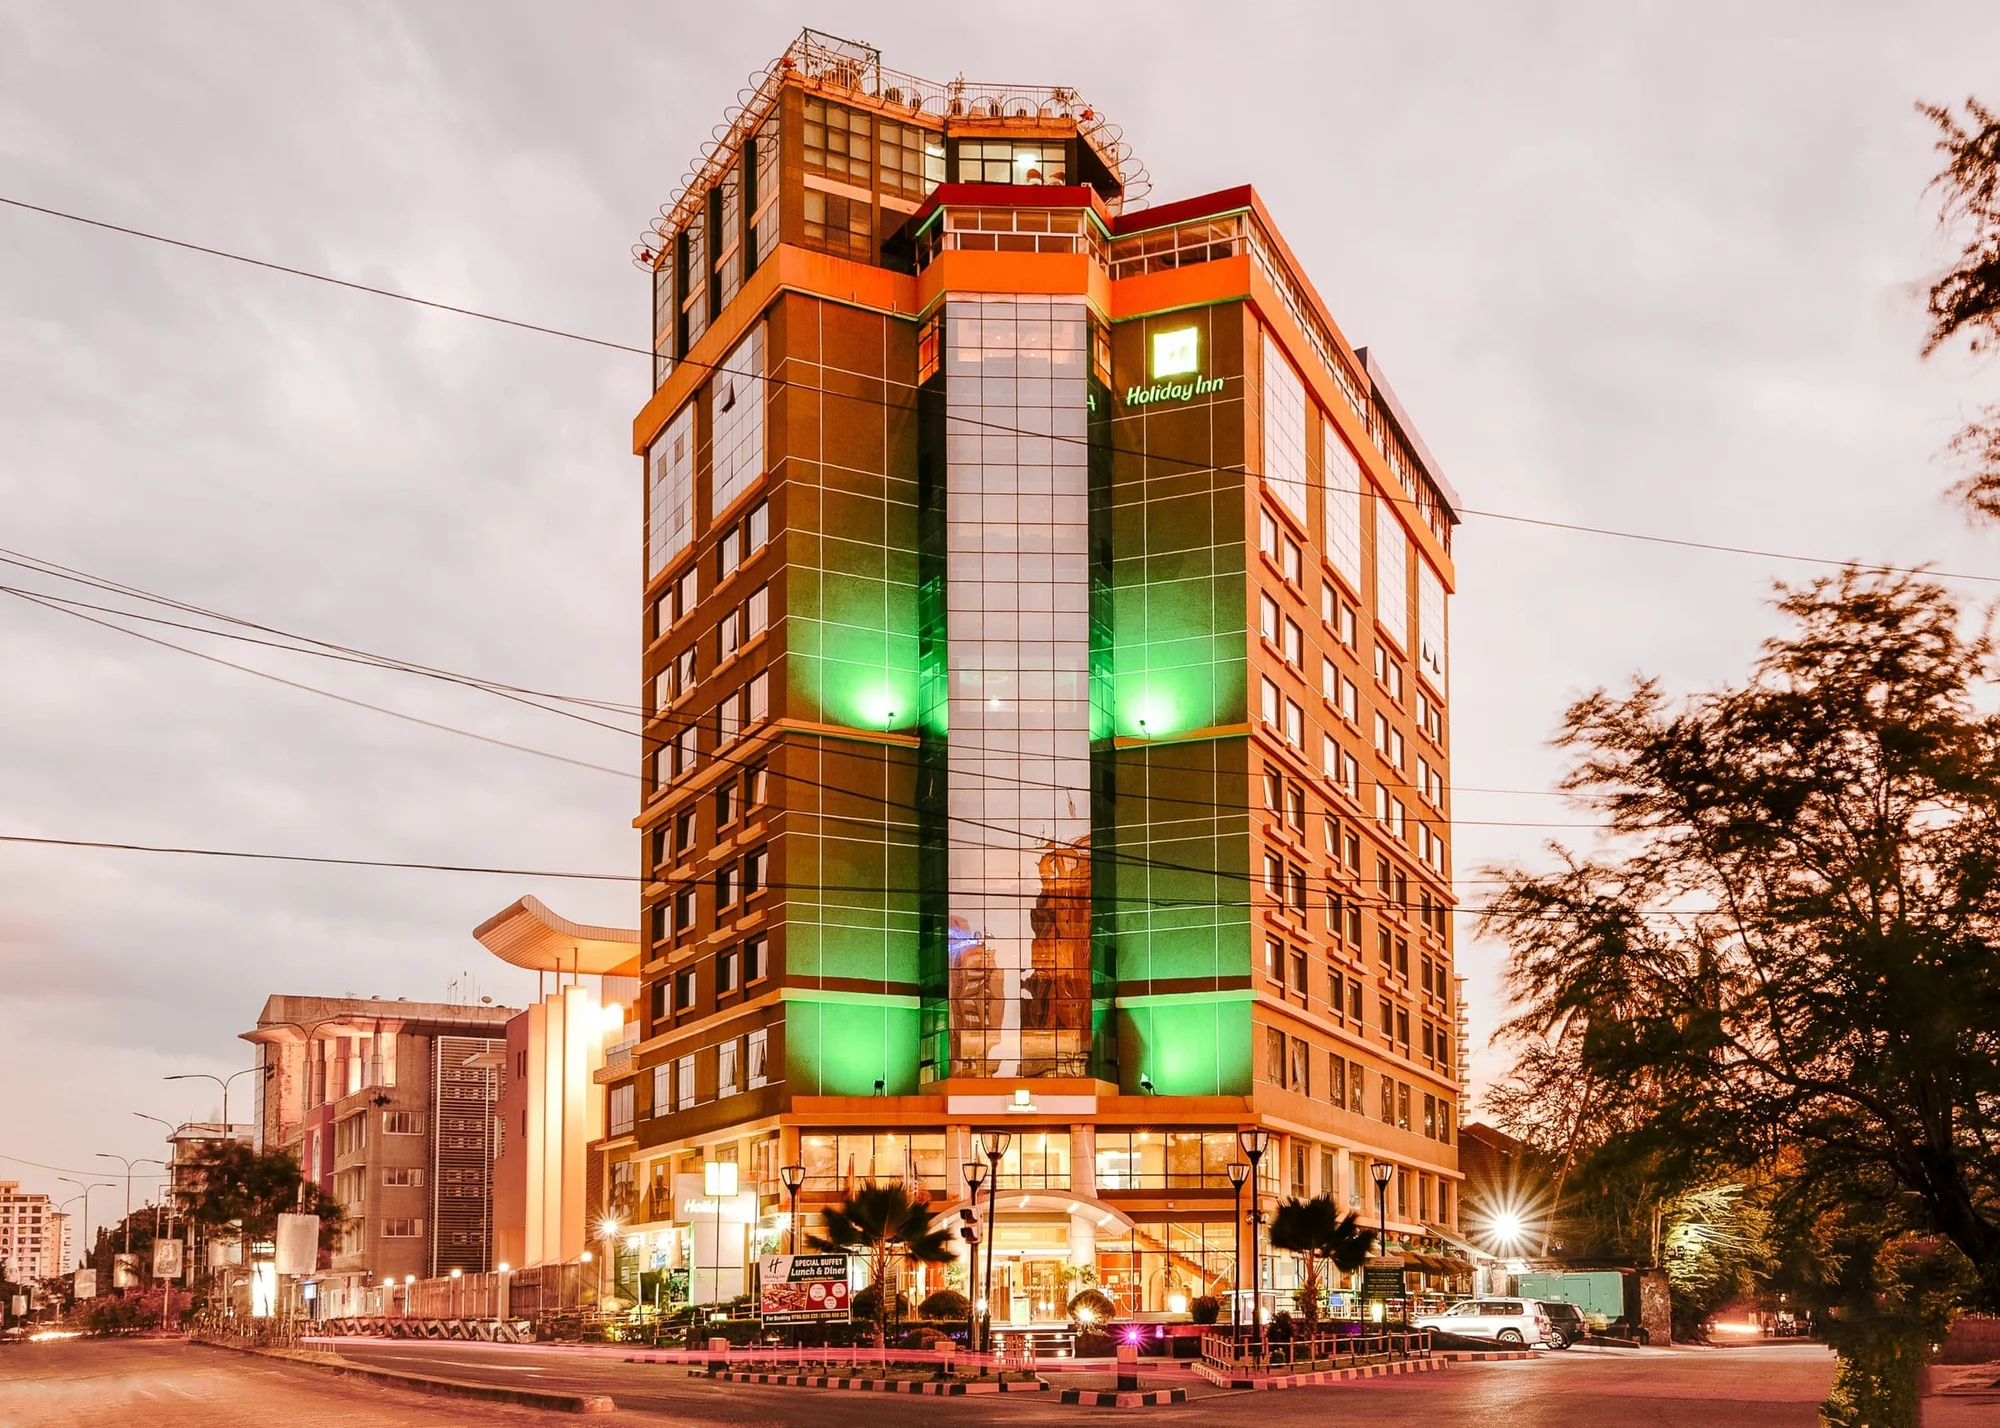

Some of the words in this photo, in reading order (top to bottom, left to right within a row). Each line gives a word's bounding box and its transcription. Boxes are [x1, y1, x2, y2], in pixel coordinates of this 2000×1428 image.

[1126, 381, 1194, 406] Holiday
[1196, 375, 1224, 394] Inn
[795, 1259, 820, 1267] SPECIAL
[821, 1258, 843, 1266] BUFFET
[791, 1267, 815, 1277] Lunch
[816, 1267, 823, 1275] &
